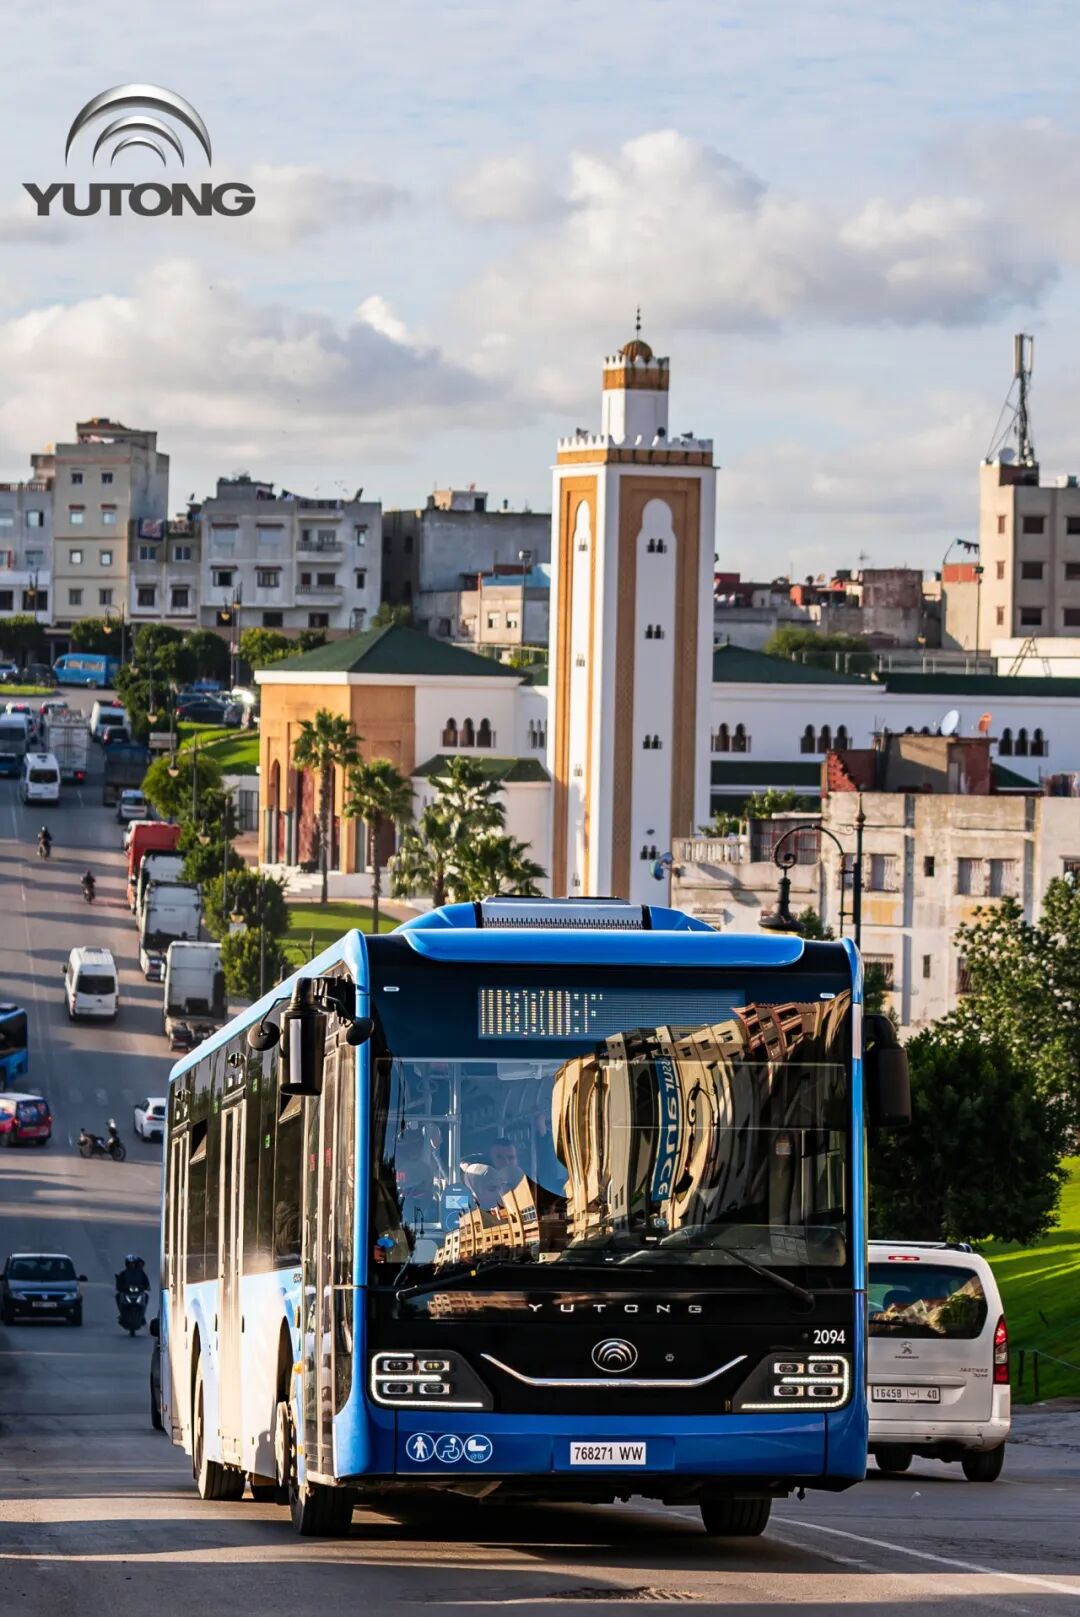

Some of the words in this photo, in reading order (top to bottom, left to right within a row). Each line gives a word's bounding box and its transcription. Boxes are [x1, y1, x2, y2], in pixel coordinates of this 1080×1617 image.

[528, 1304, 702, 1313] YUTONG
[813, 1329, 846, 1344] 2094
[927, 1390, 937, 1399] 40
[574, 1446, 613, 1460] 768271
[619, 1446, 643, 1460] WW
